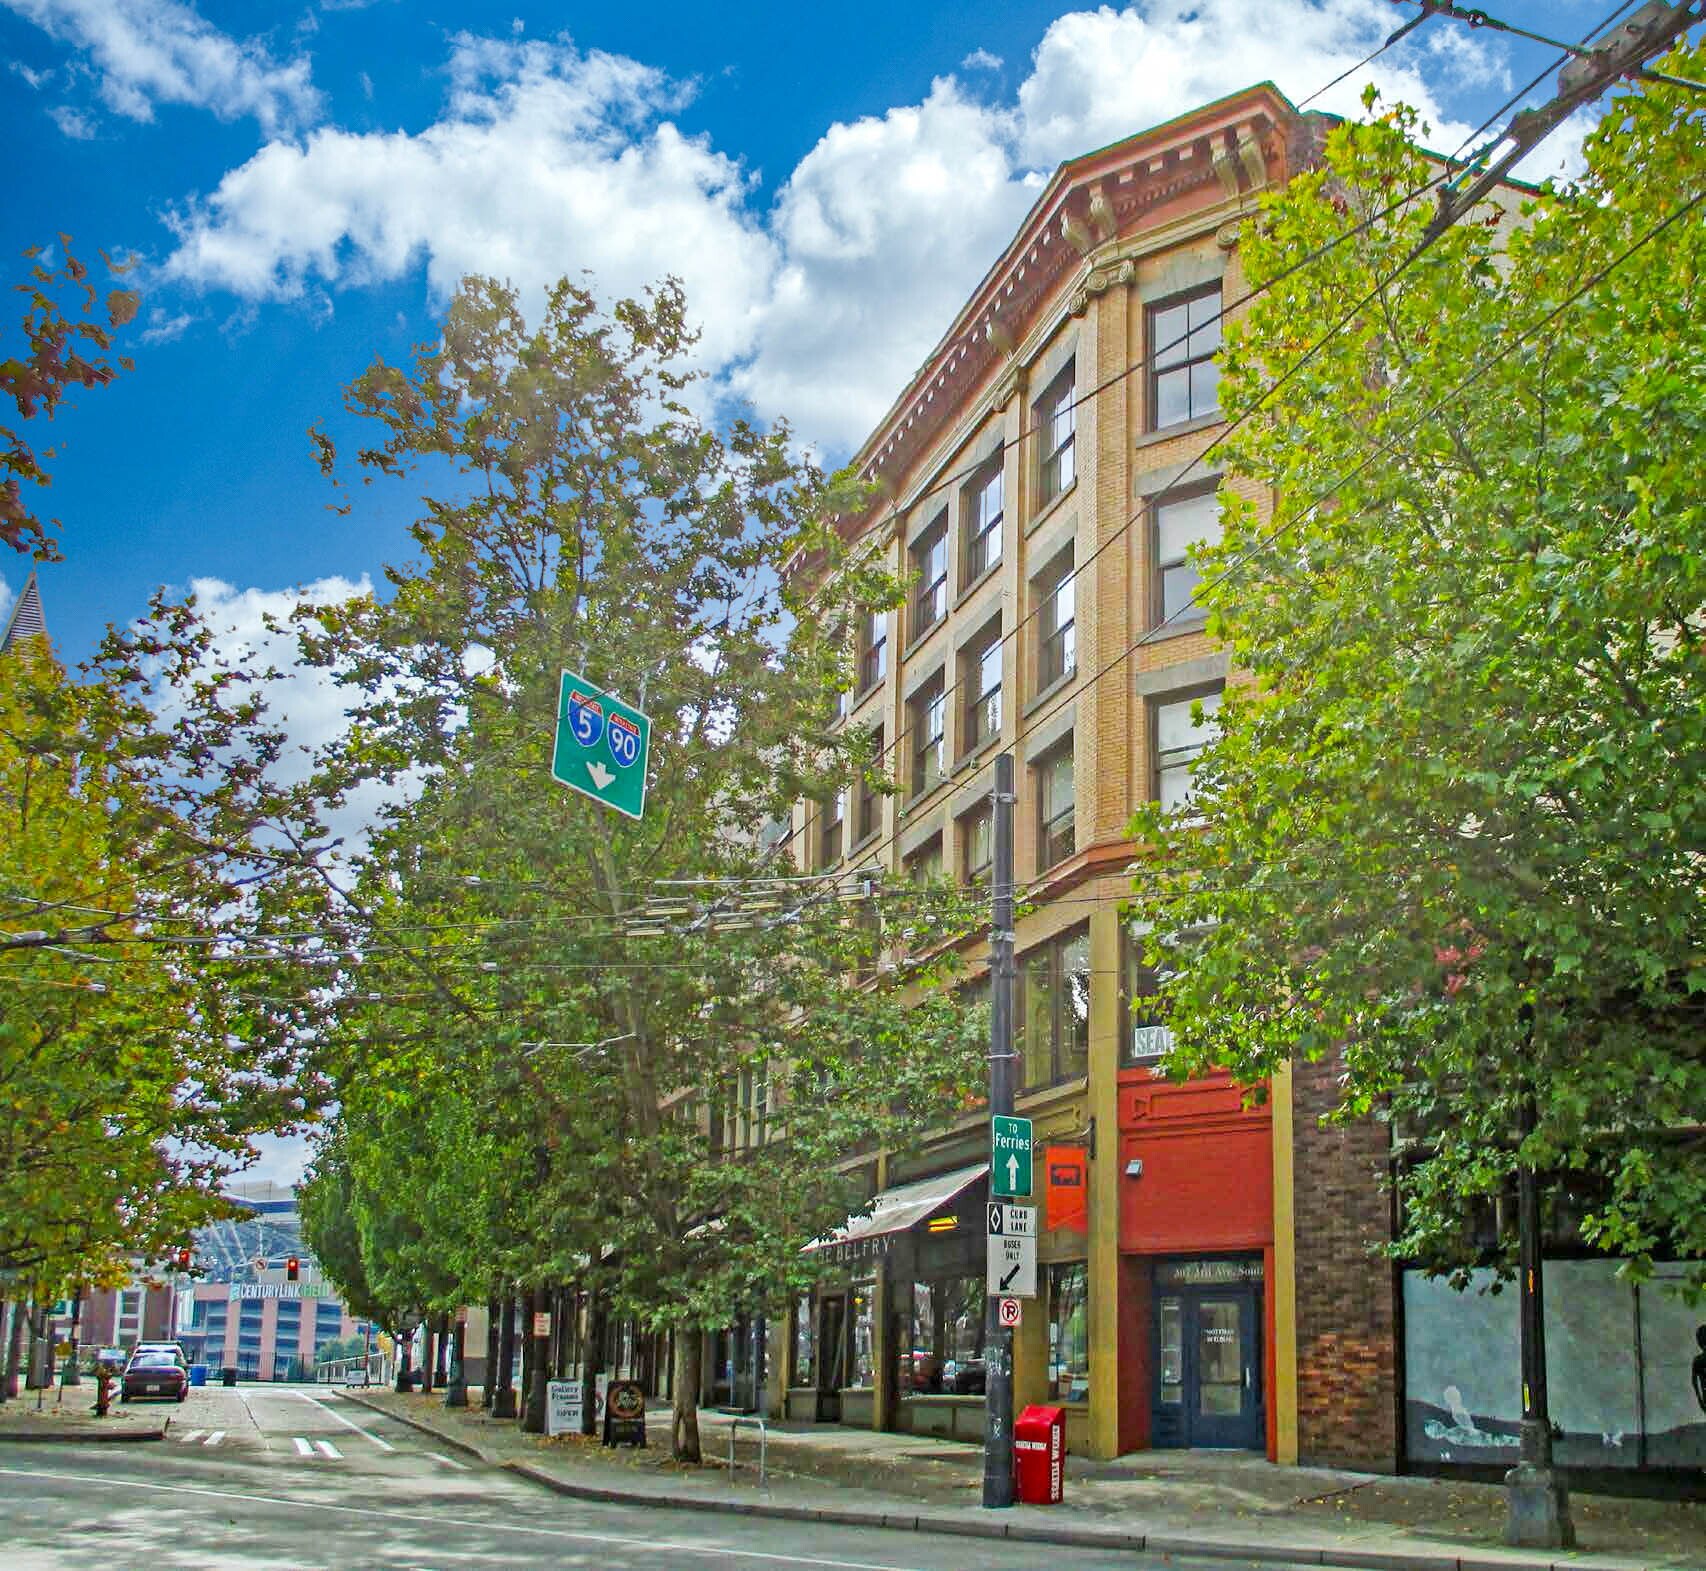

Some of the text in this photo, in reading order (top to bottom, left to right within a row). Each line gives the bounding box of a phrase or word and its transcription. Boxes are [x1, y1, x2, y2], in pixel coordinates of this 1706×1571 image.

[577, 708, 592, 739] 5
[611, 728, 636, 760] 90
[1008, 1122, 1018, 1134] TO
[995, 1132, 1030, 1150] Ferries
[1010, 1208, 1028, 1220] CURB
[1010, 1222, 1028, 1233] LANE
[1003, 1239, 1021, 1250] BUSES
